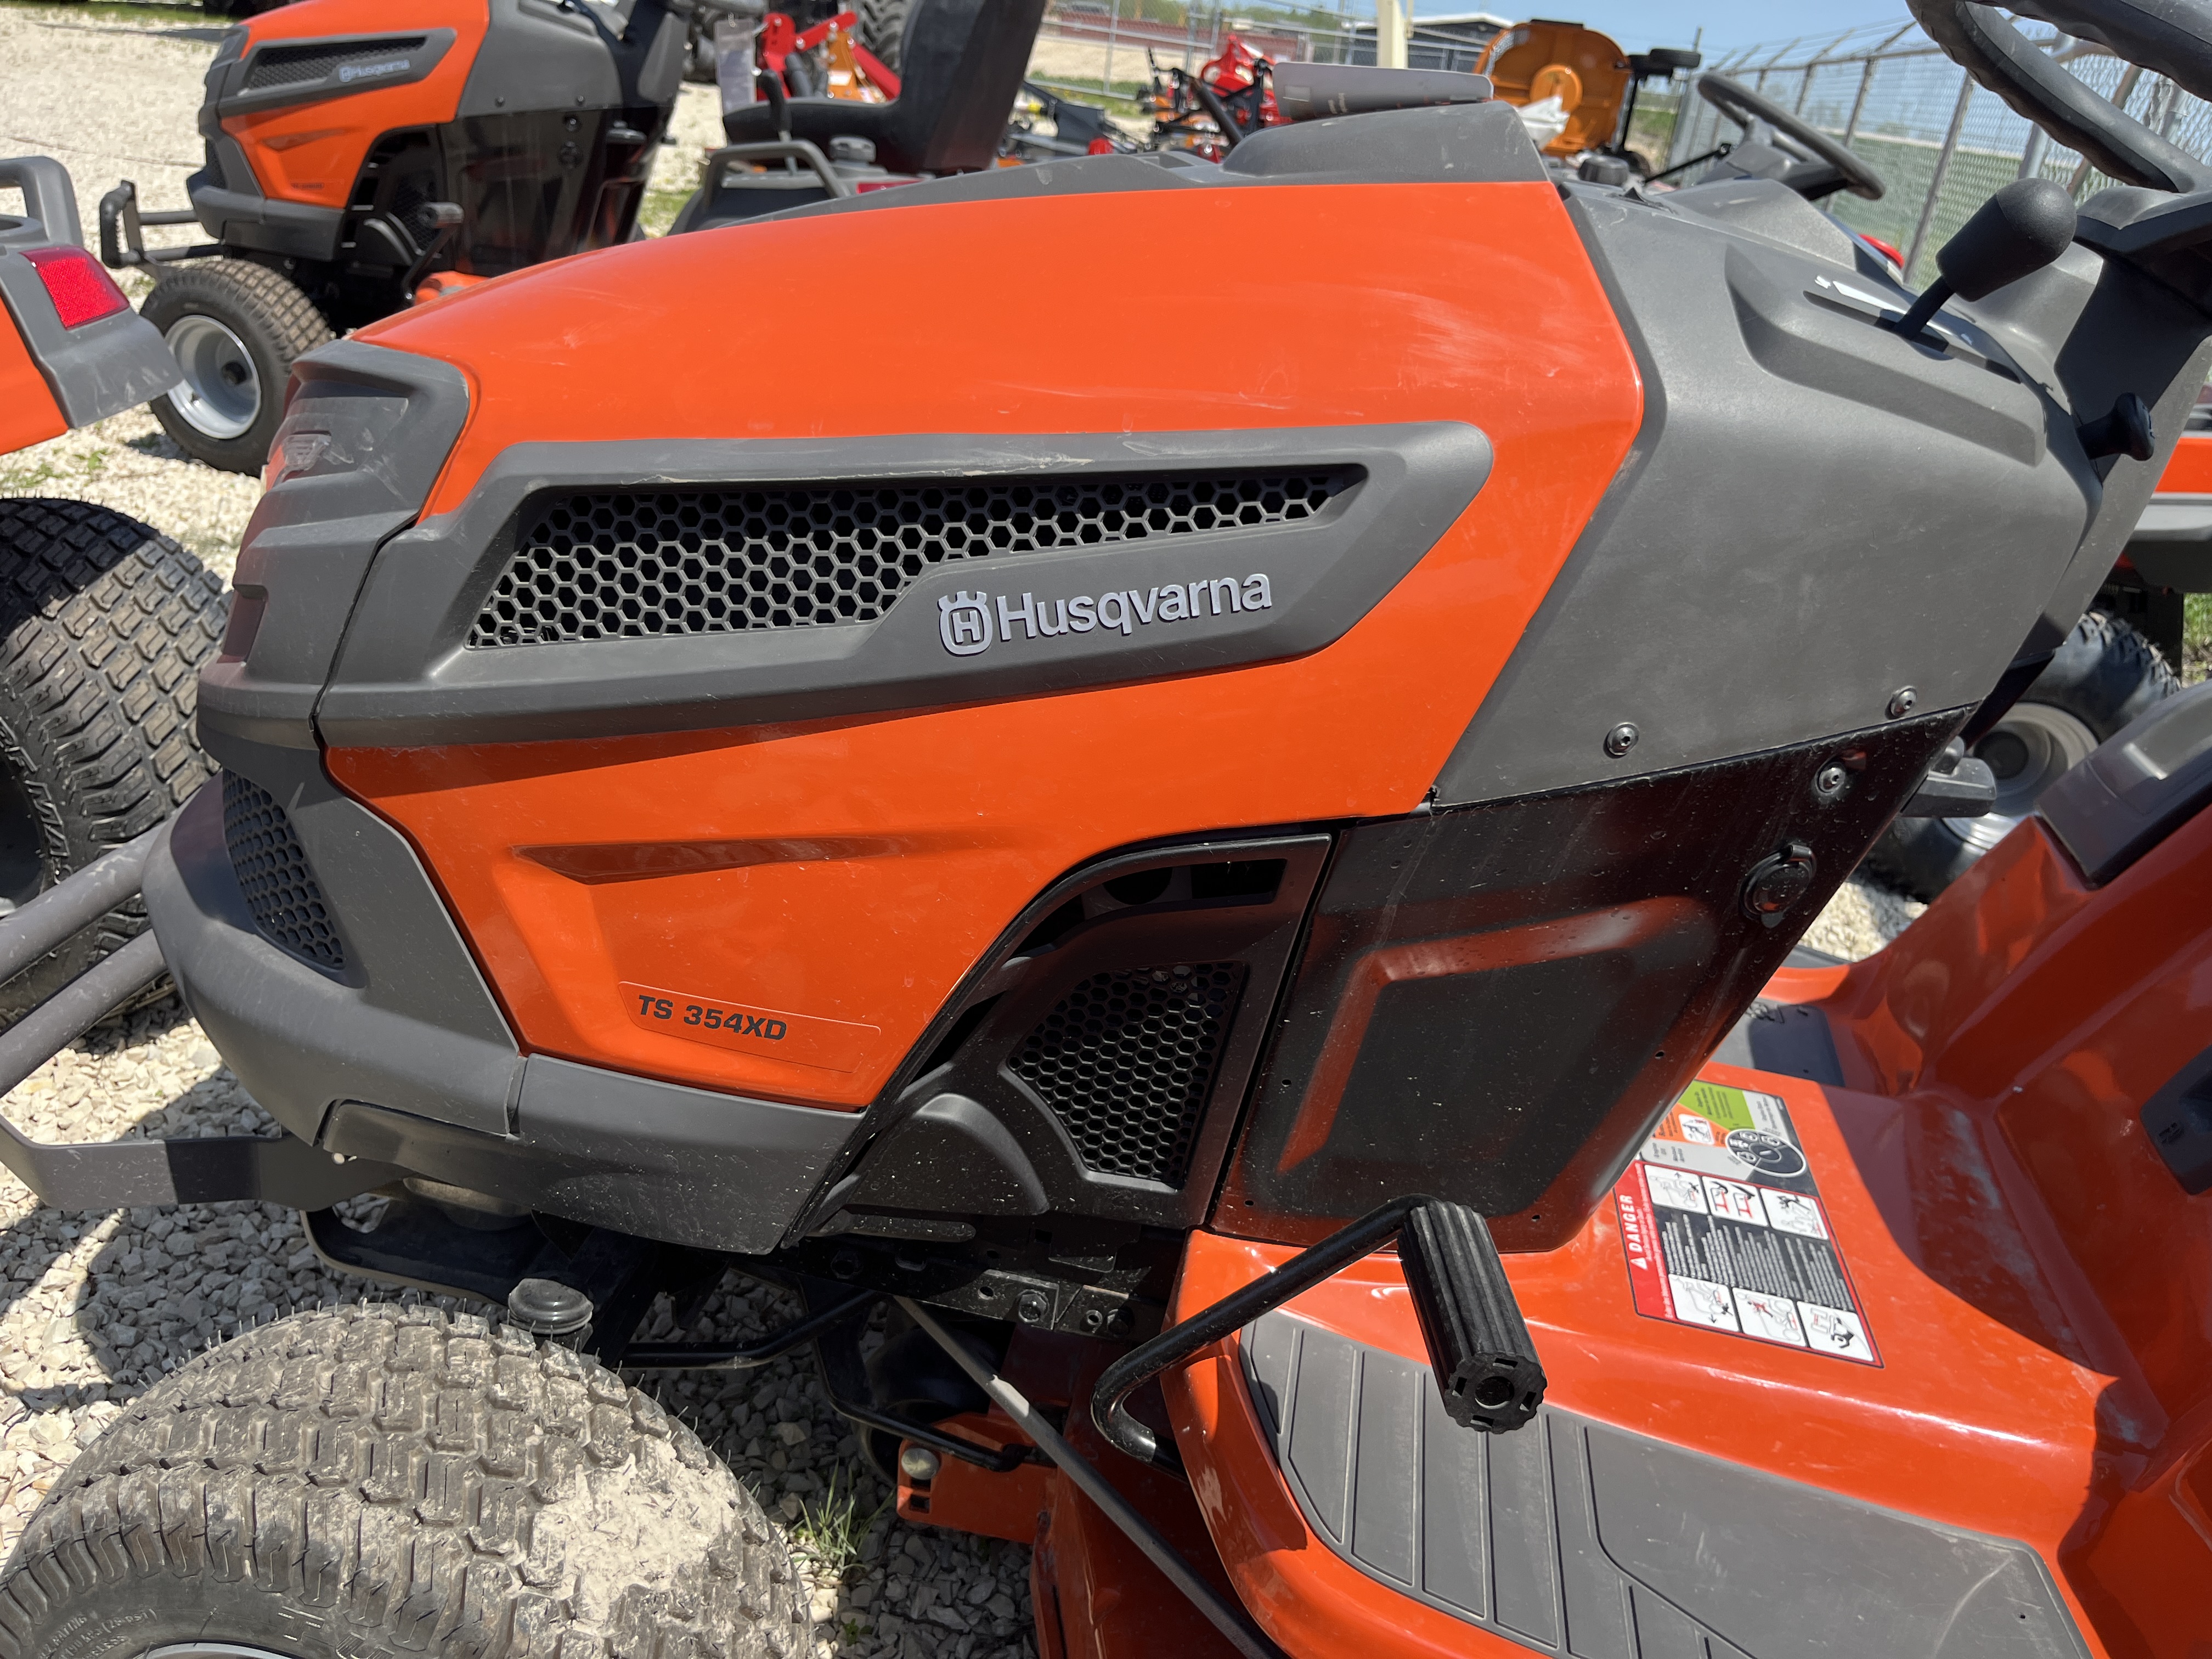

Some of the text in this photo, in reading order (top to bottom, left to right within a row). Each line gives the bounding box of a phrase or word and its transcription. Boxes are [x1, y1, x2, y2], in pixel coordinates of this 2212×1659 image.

[996, 573, 1273, 641] Husqvarna
[638, 995, 787, 1041] TS 354XD
[1619, 1194, 1644, 1253] DANGER
